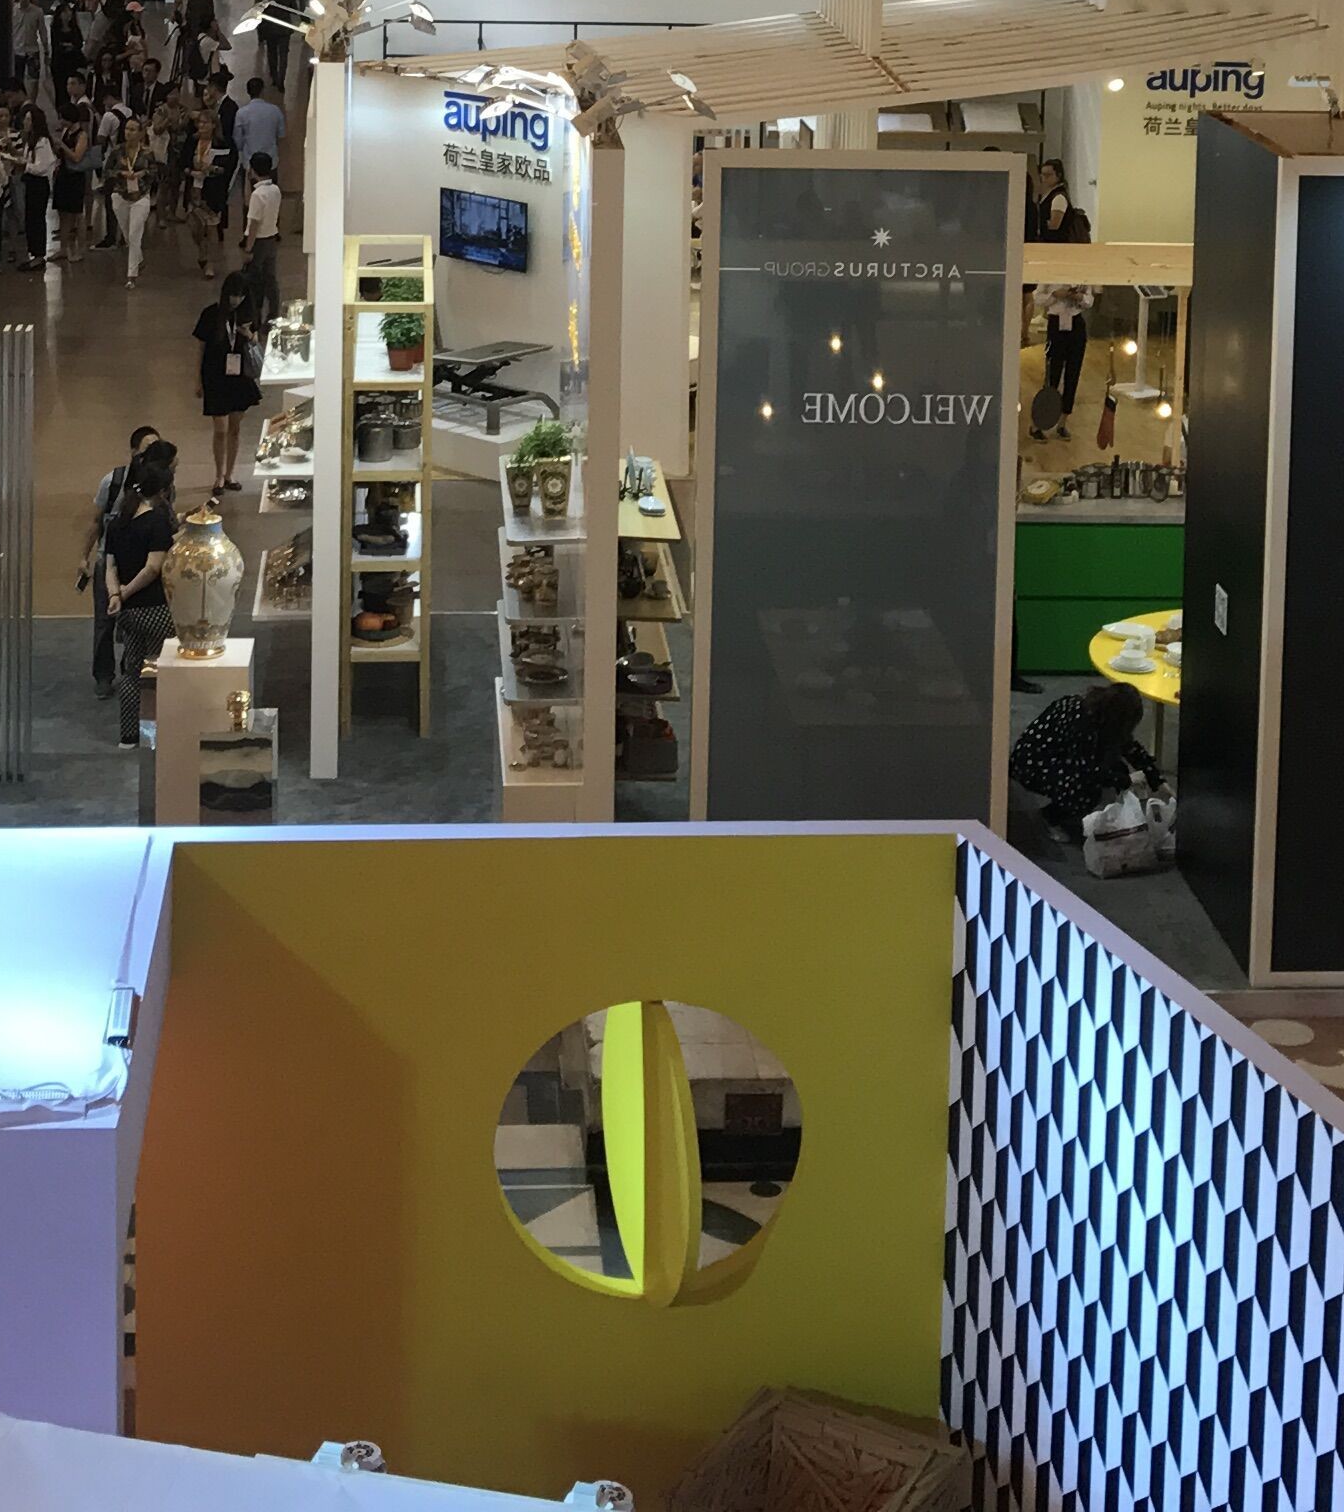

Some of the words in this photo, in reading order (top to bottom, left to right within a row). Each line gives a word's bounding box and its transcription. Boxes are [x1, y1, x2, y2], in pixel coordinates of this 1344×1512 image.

[1146, 62, 1265, 100] auping
[443, 90, 549, 151] auping
[443, 143, 552, 183] 荷兰皇家欧品
